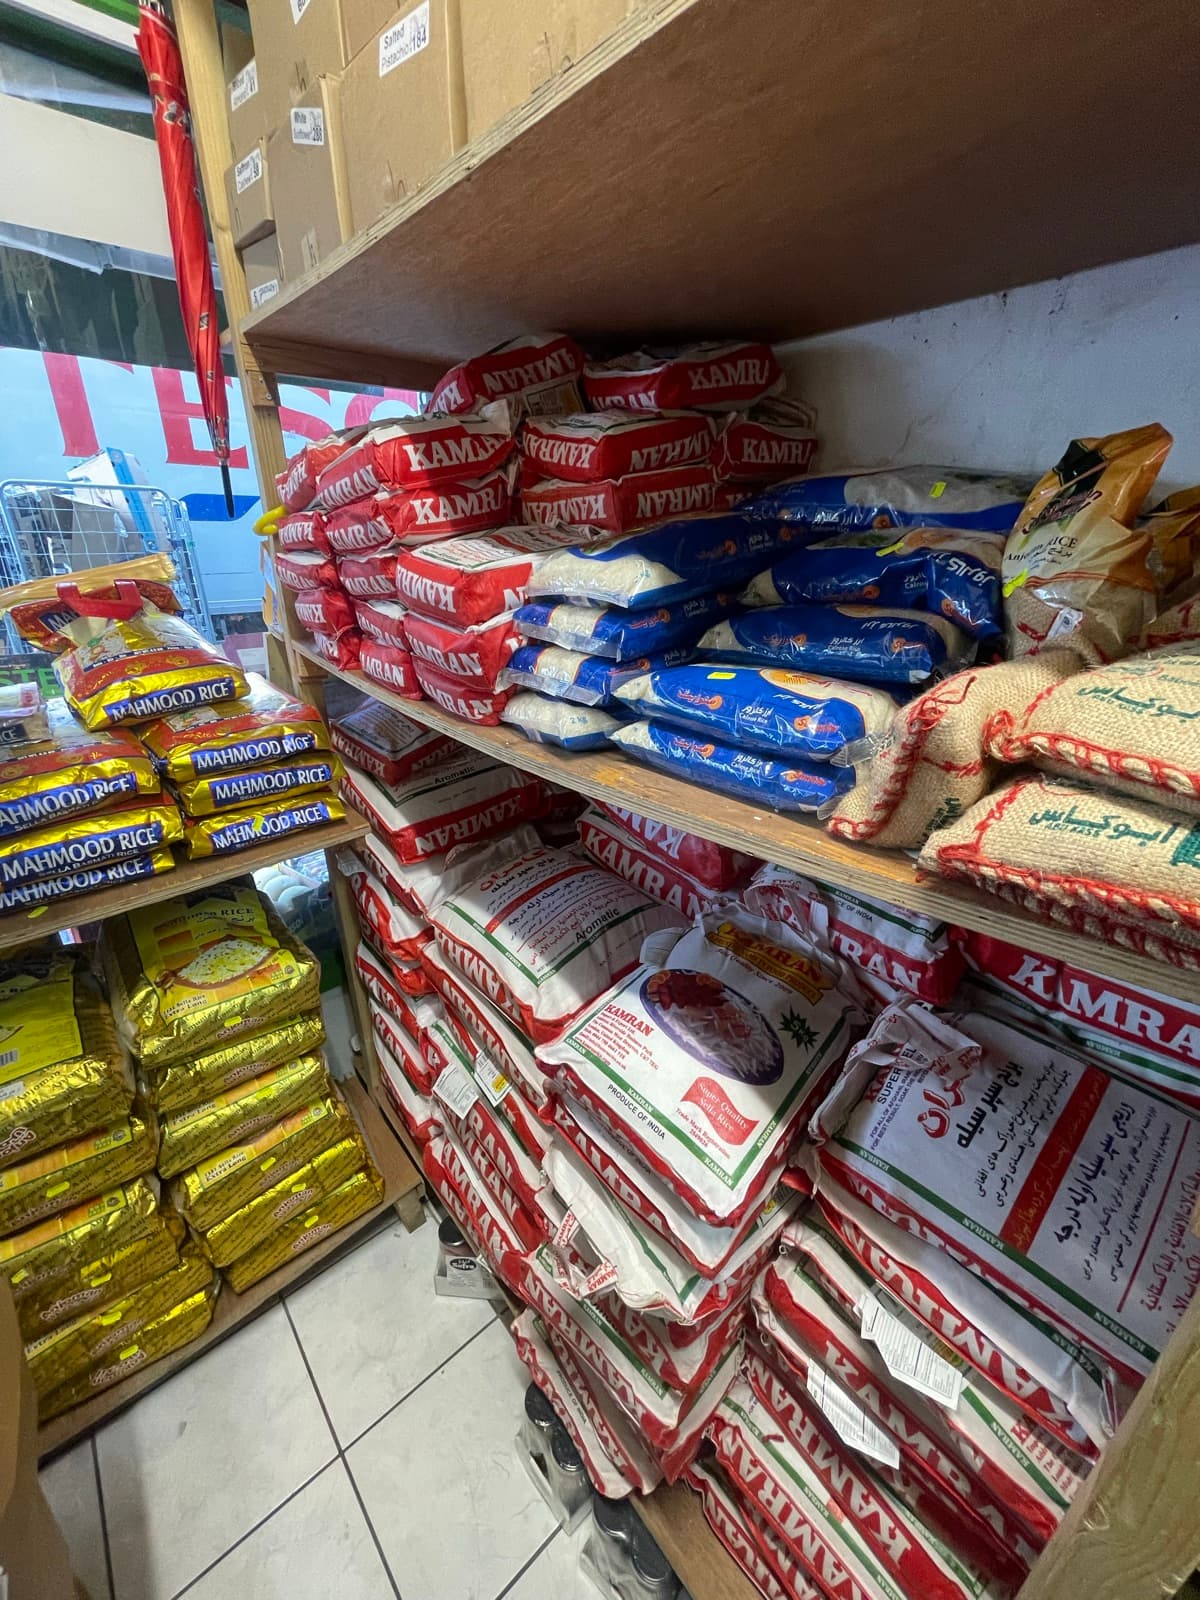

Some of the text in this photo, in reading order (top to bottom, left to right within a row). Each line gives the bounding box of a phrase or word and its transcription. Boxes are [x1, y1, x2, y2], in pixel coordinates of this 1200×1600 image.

[412, 24, 427, 52] 184
[110, 681, 231, 723] MAHMOOD RICE
[196, 734, 313, 771] MAHMOOD RICE
[94, 777, 130, 797] RICE
[214, 764, 327, 801] MAHMOOD RICE
[291, 806, 323, 827] RICE
[2, 826, 158, 881] MAHMOOD RICE
[106, 857, 145, 879] RICE
[572, 909, 622, 942] Aromatic
[604, 1004, 655, 1036] KAMRAN
[642, 1046, 653, 1057] Park
[876, 1068, 904, 1103] SUPER
[607, 1084, 666, 1141] PRODUCE OF INDIA
[675, 1107, 690, 1122] Trade
[688, 1118, 703, 1134] Mark
[698, 1083, 748, 1130] Super Quality
[698, 1098, 735, 1132] Sella Rice
[703, 1157, 734, 1187] KAMRAN
[961, 1216, 1004, 1251] KAMRAN
[1054, 1208, 1087, 1245] درجه
[750, 1357, 911, 1562] KAMRAN
